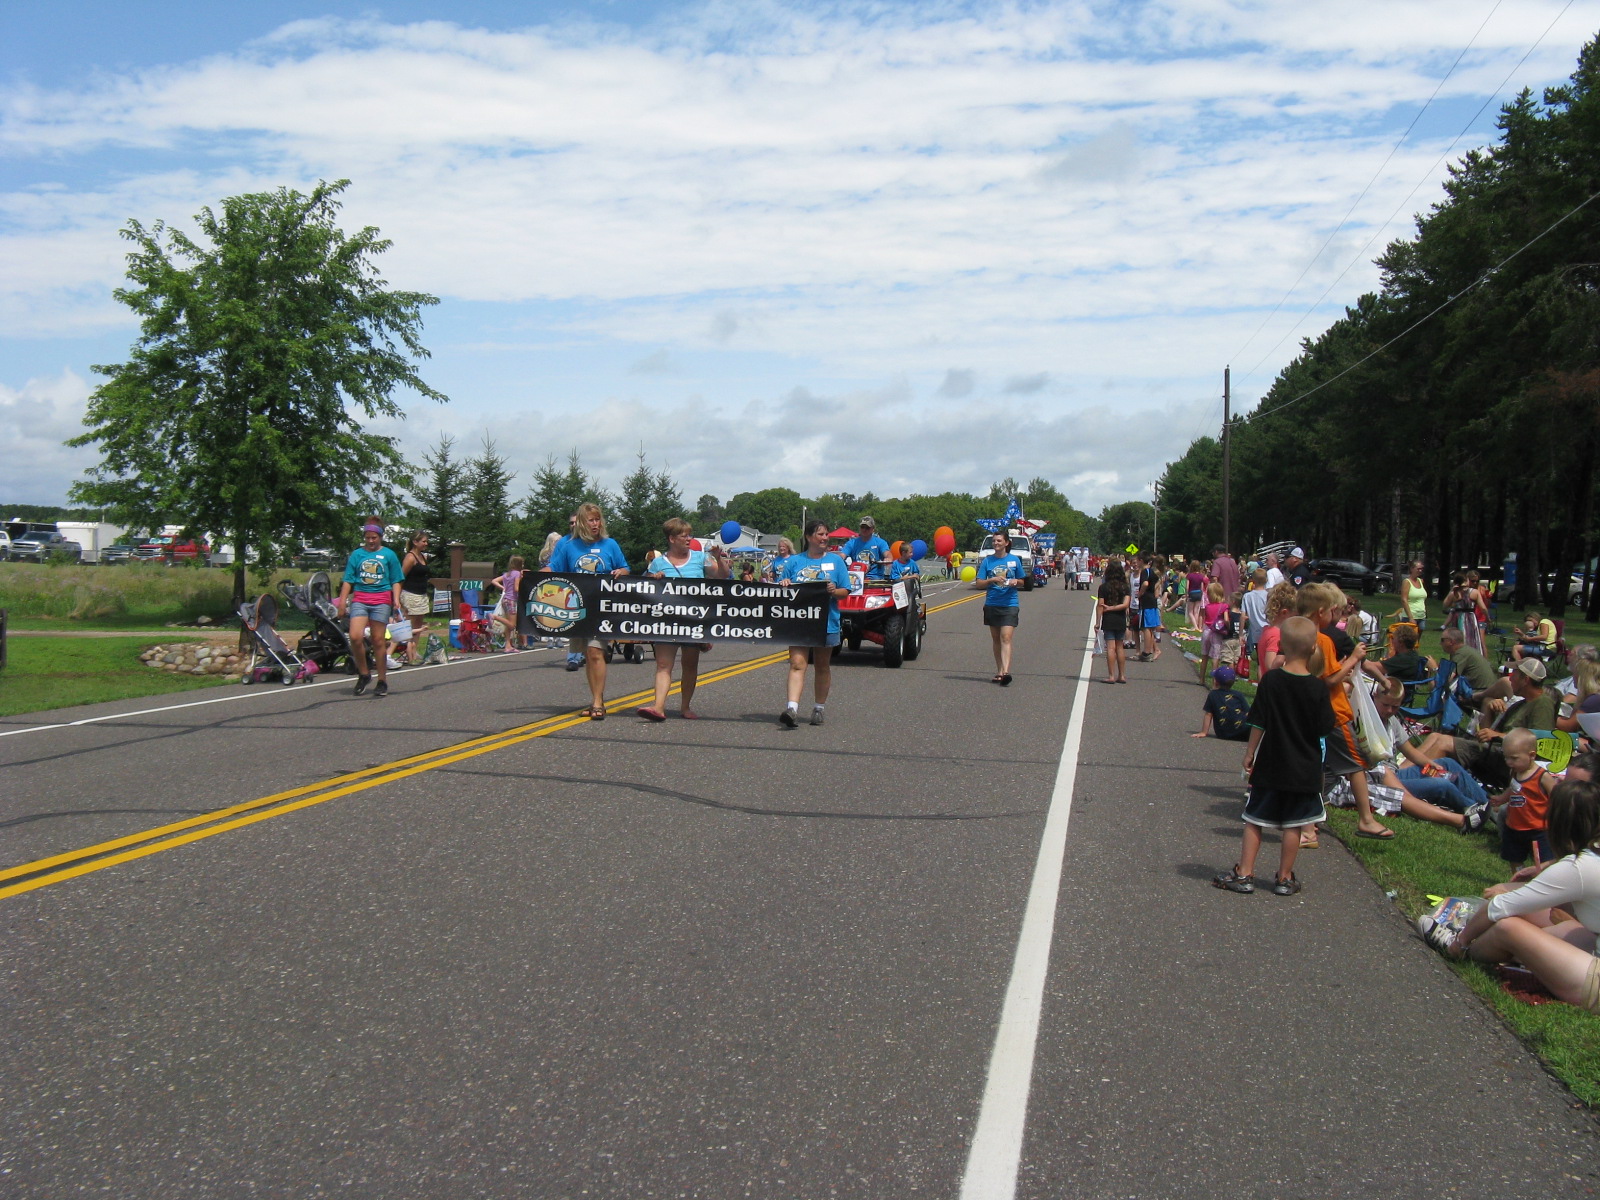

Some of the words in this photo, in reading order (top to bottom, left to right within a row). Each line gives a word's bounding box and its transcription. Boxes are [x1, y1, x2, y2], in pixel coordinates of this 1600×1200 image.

[459, 580, 483, 591] 22174
[600, 579, 655, 595] North
[661, 582, 724, 597] Anoka
[730, 584, 800, 601] County
[530, 603, 581, 620] NACE
[599, 599, 710, 619] Emergency
[716, 603, 764, 618] Food
[770, 605, 821, 619] Shelf
[598, 619, 613, 633] &
[619, 620, 705, 639] Clothing
[710, 623, 773, 639] Closet
